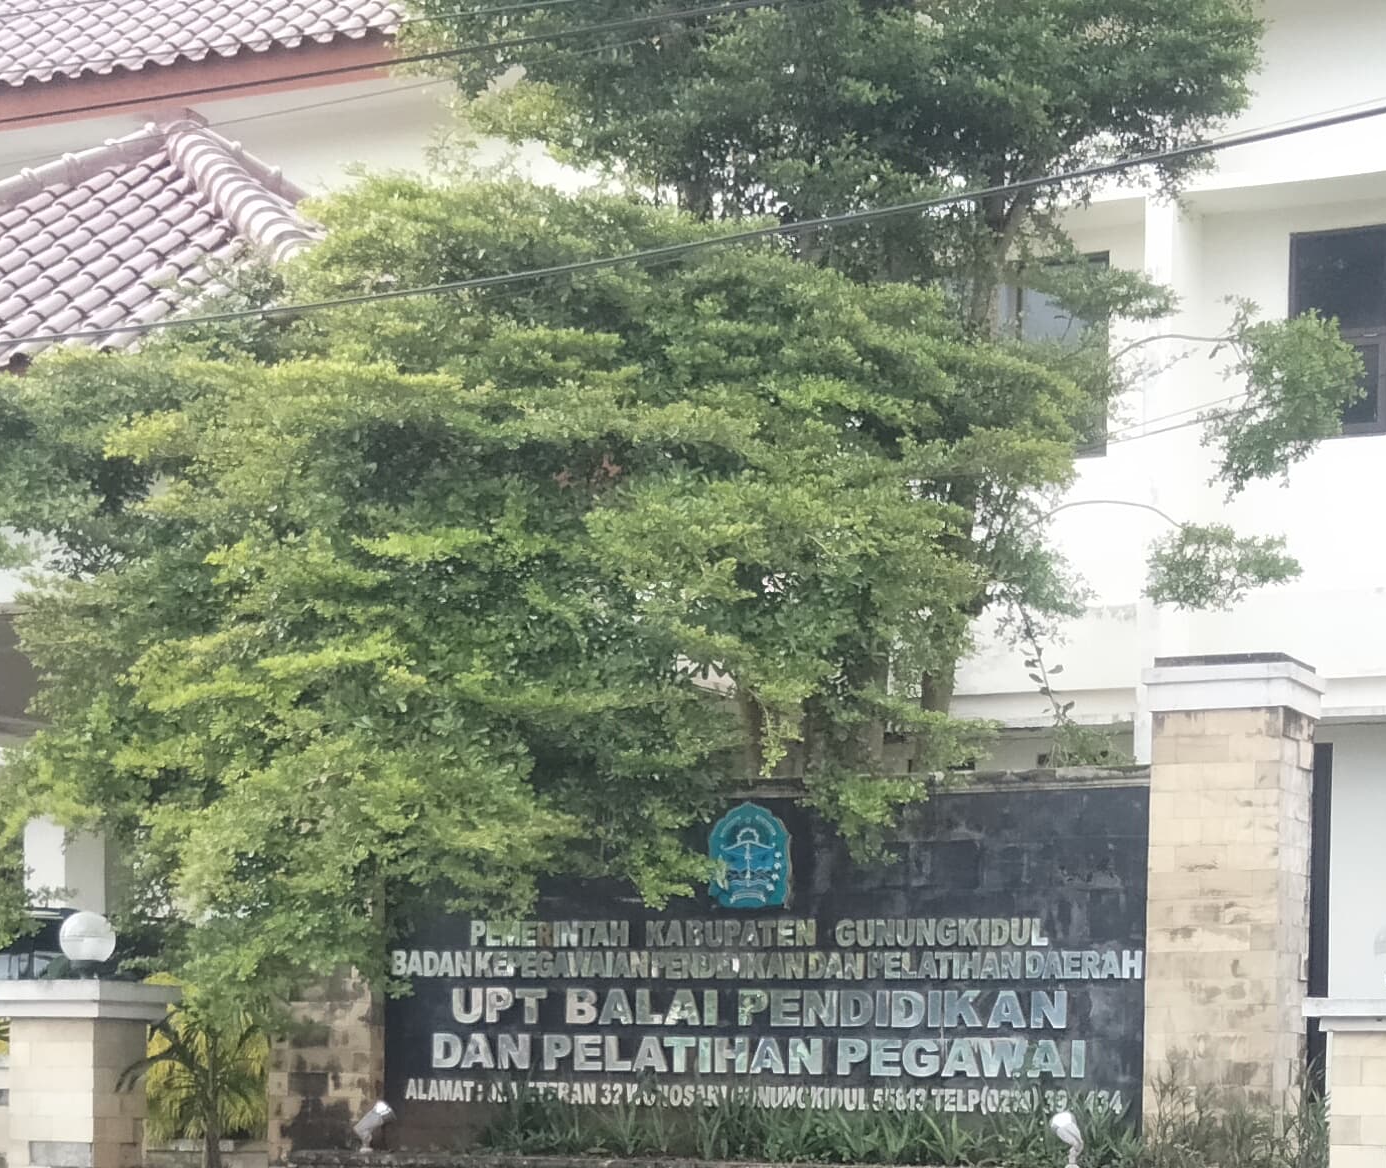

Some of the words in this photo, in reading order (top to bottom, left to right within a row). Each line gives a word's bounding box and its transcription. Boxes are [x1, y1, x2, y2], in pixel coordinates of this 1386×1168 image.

[470, 919, 630, 947] PEMERINTAH
[645, 918, 818, 947] KABUPATEN
[834, 917, 1050, 947] GUNUNGKIDUL
[391, 950, 472, 978] BADAN
[474, 950, 650, 979] KEPEGAWAIAN
[651, 950, 805, 980] PENDIDIKAN
[808, 951, 864, 981] DAN
[867, 950, 1022, 980] PELATIHAN
[1025, 950, 1143, 979] DAERAH
[451, 986, 548, 1025] UPT
[565, 987, 719, 1026] BALAI
[738, 989, 1068, 1029] PENDIDIKAN
[431, 1031, 532, 1071] DAN
[542, 1033, 824, 1075] PELATIHAN
[835, 1037, 1087, 1079] PEGAWAI
[510, 1081, 597, 1105] VTRAN
[730, 1085, 871, 1112] NUNGKIDUL
